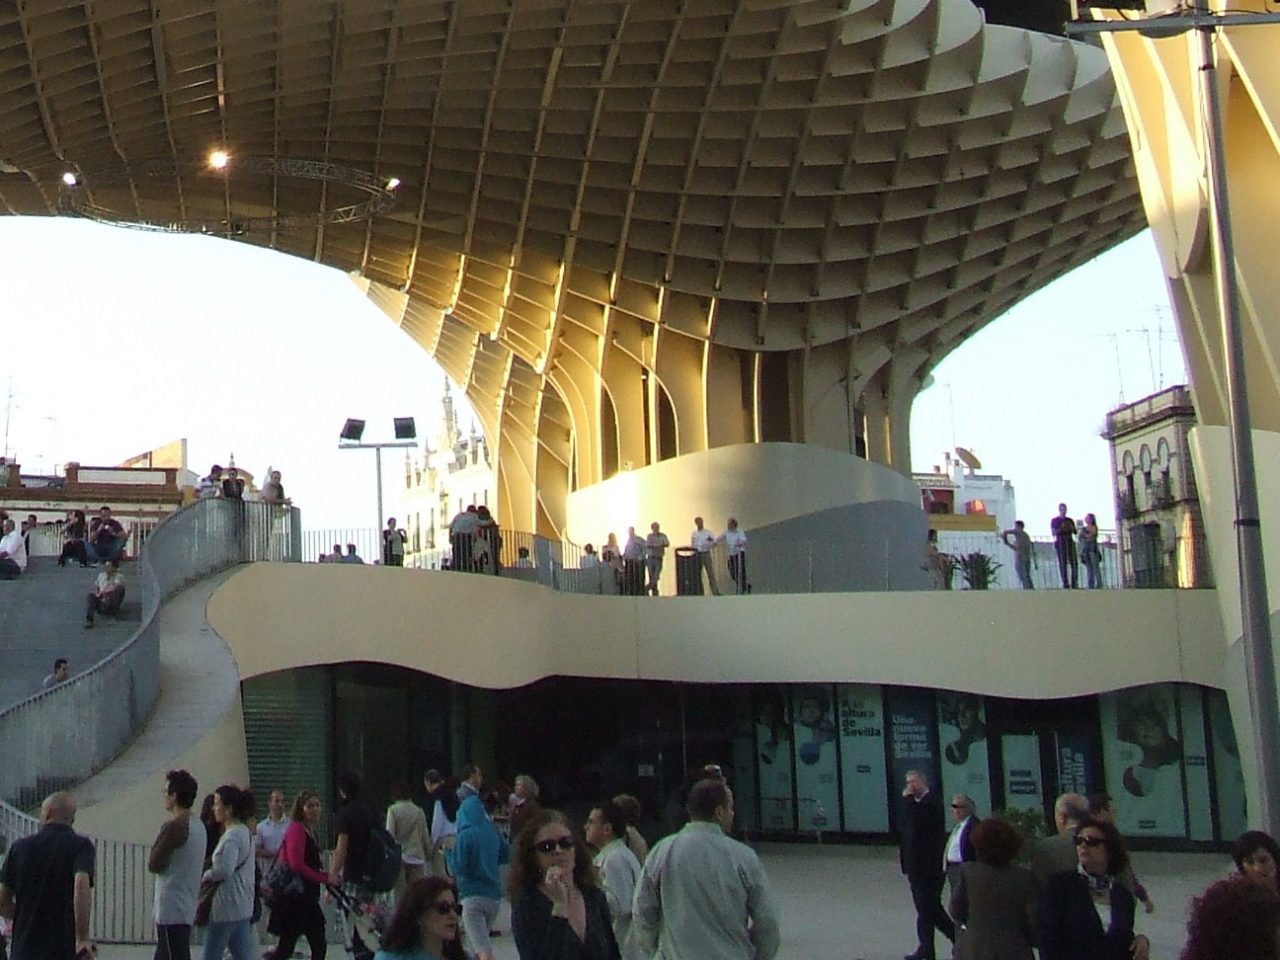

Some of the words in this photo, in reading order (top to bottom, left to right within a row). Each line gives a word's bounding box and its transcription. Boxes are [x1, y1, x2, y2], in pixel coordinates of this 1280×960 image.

[841, 718, 856, 727] de
[842, 726, 881, 737] Sevilla
[1073, 752, 1086, 794] evilla
